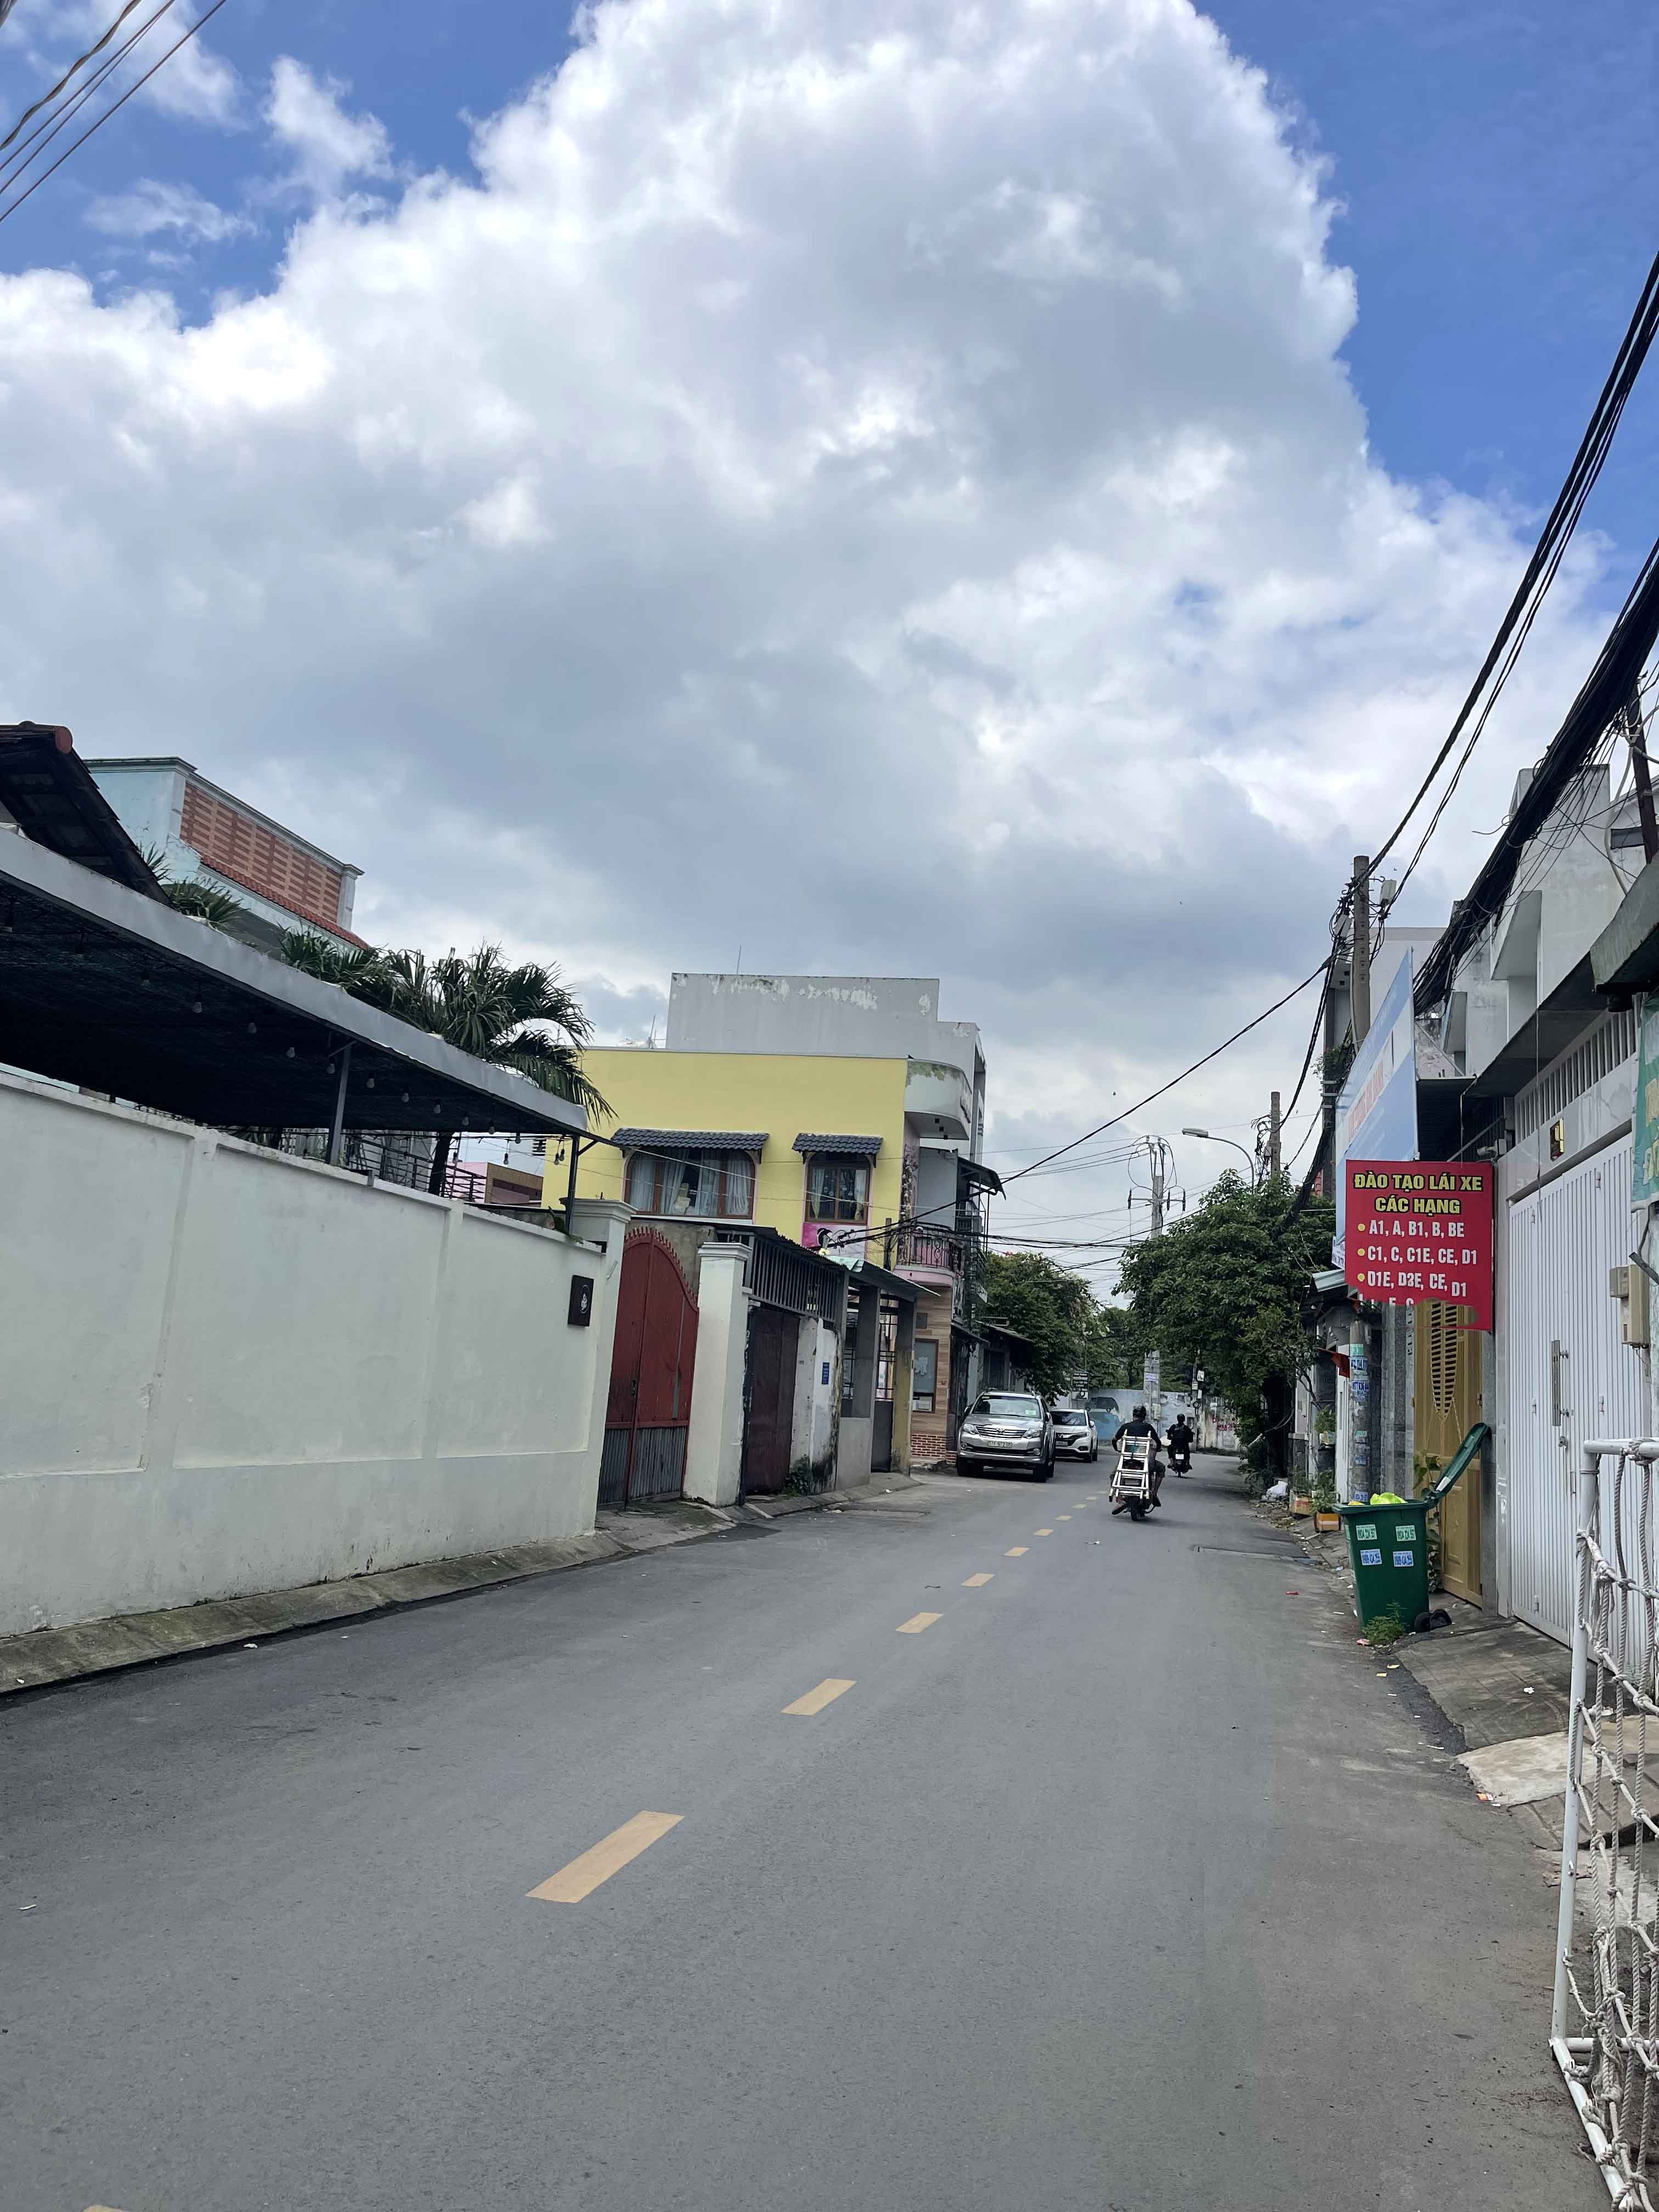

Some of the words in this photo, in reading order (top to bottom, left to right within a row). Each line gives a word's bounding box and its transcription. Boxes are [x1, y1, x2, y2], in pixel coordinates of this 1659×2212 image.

[1354, 1171, 1388, 1188] ĐÀO
[1392, 1174, 1424, 1192] TẠO
[1429, 1173, 1455, 1190] LÁI
[1460, 1176, 1482, 1190] XE
[1375, 1195, 1409, 1212] CÁC
[1414, 1198, 1460, 1216] HẠNG
[1369, 1220, 1389, 1237] A1,
[1392, 1220, 1404, 1237] A,
[1408, 1221, 1428, 1238] B1,
[1432, 1221, 1444, 1238] B,
[1448, 1222, 1464, 1238] BE
[1368, 1246, 1387, 1263] C1,
[1391, 1246, 1403, 1263] C,
[1407, 1247, 1434, 1265] C1E,
[1438, 1248, 1458, 1266] CE,
[1462, 1249, 1477, 1265] D1
[1429, 1273, 1448, 1291] CE,
[1451, 1282, 1466, 1297] D1
